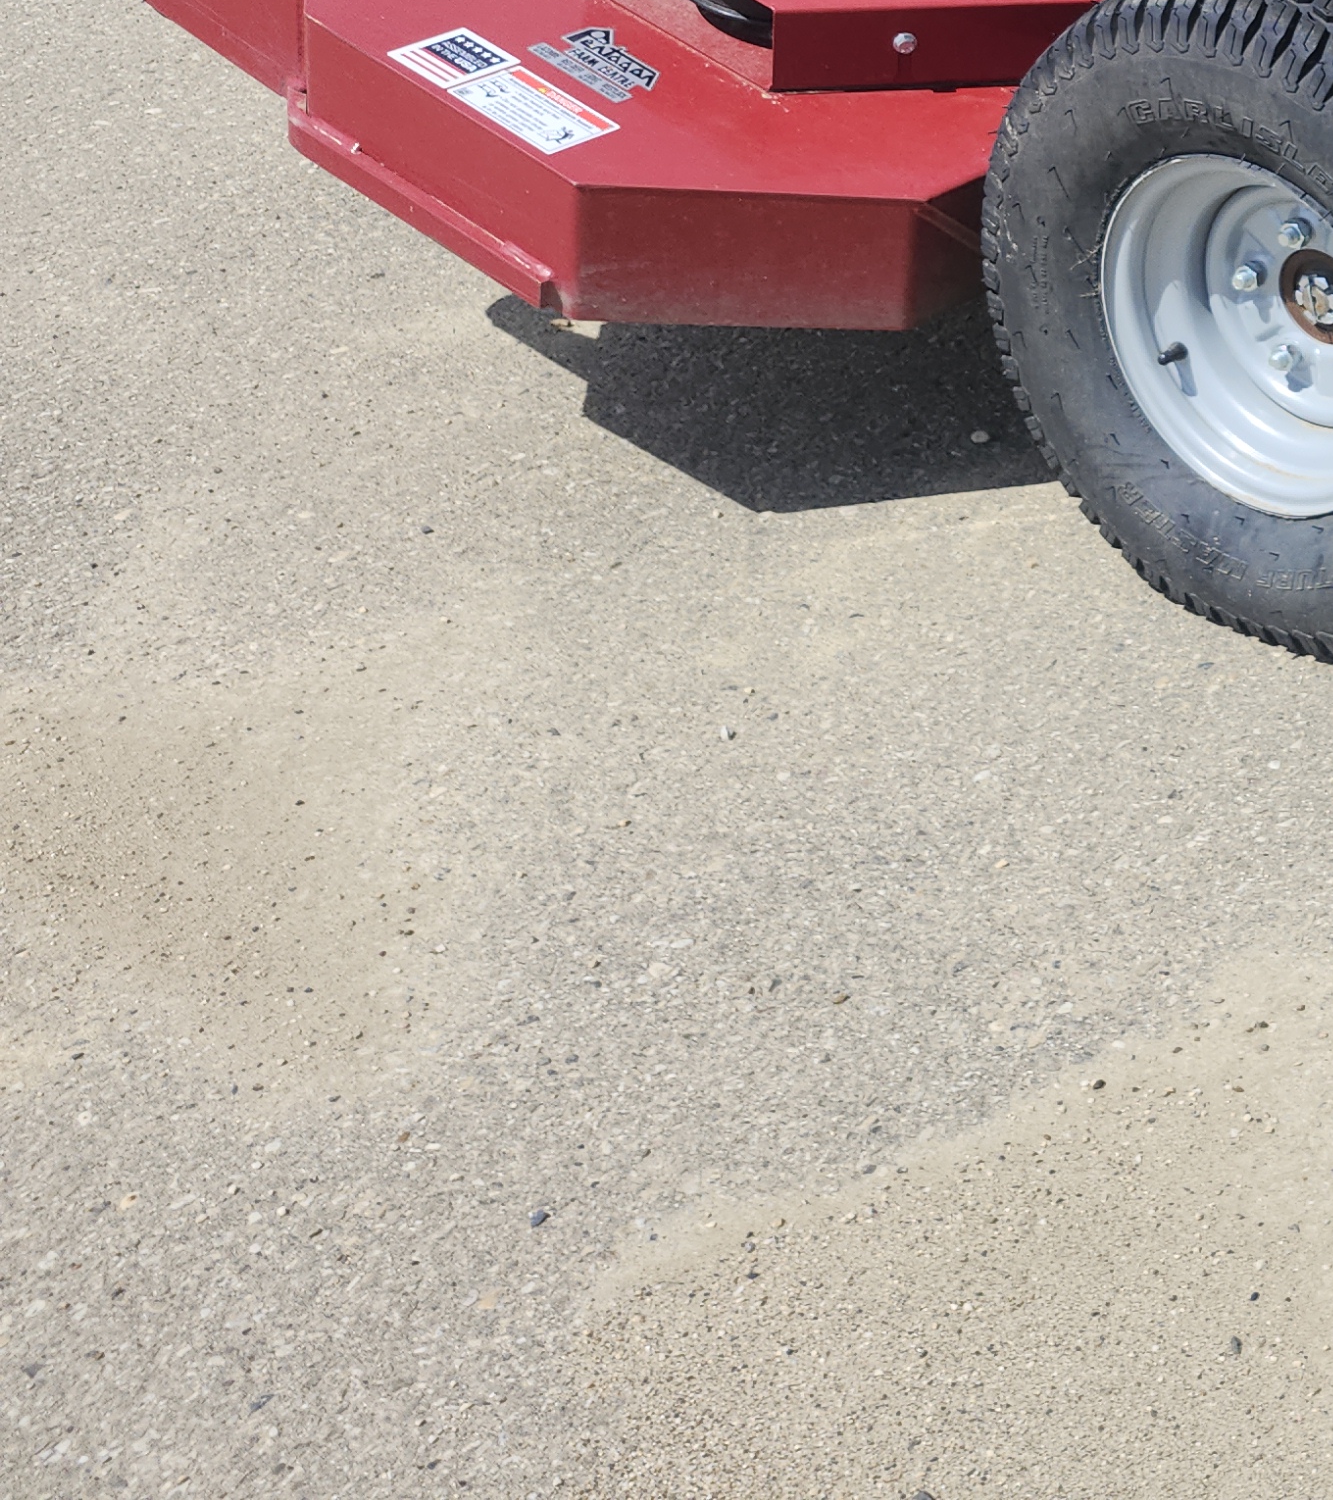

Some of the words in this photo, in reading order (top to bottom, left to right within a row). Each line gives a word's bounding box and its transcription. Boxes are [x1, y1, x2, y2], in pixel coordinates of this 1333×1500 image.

[451, 57, 480, 72] USA
[568, 48, 600, 68] FARM
[542, 90, 585, 113] DANGER
[1117, 481, 1248, 580] MASTER
